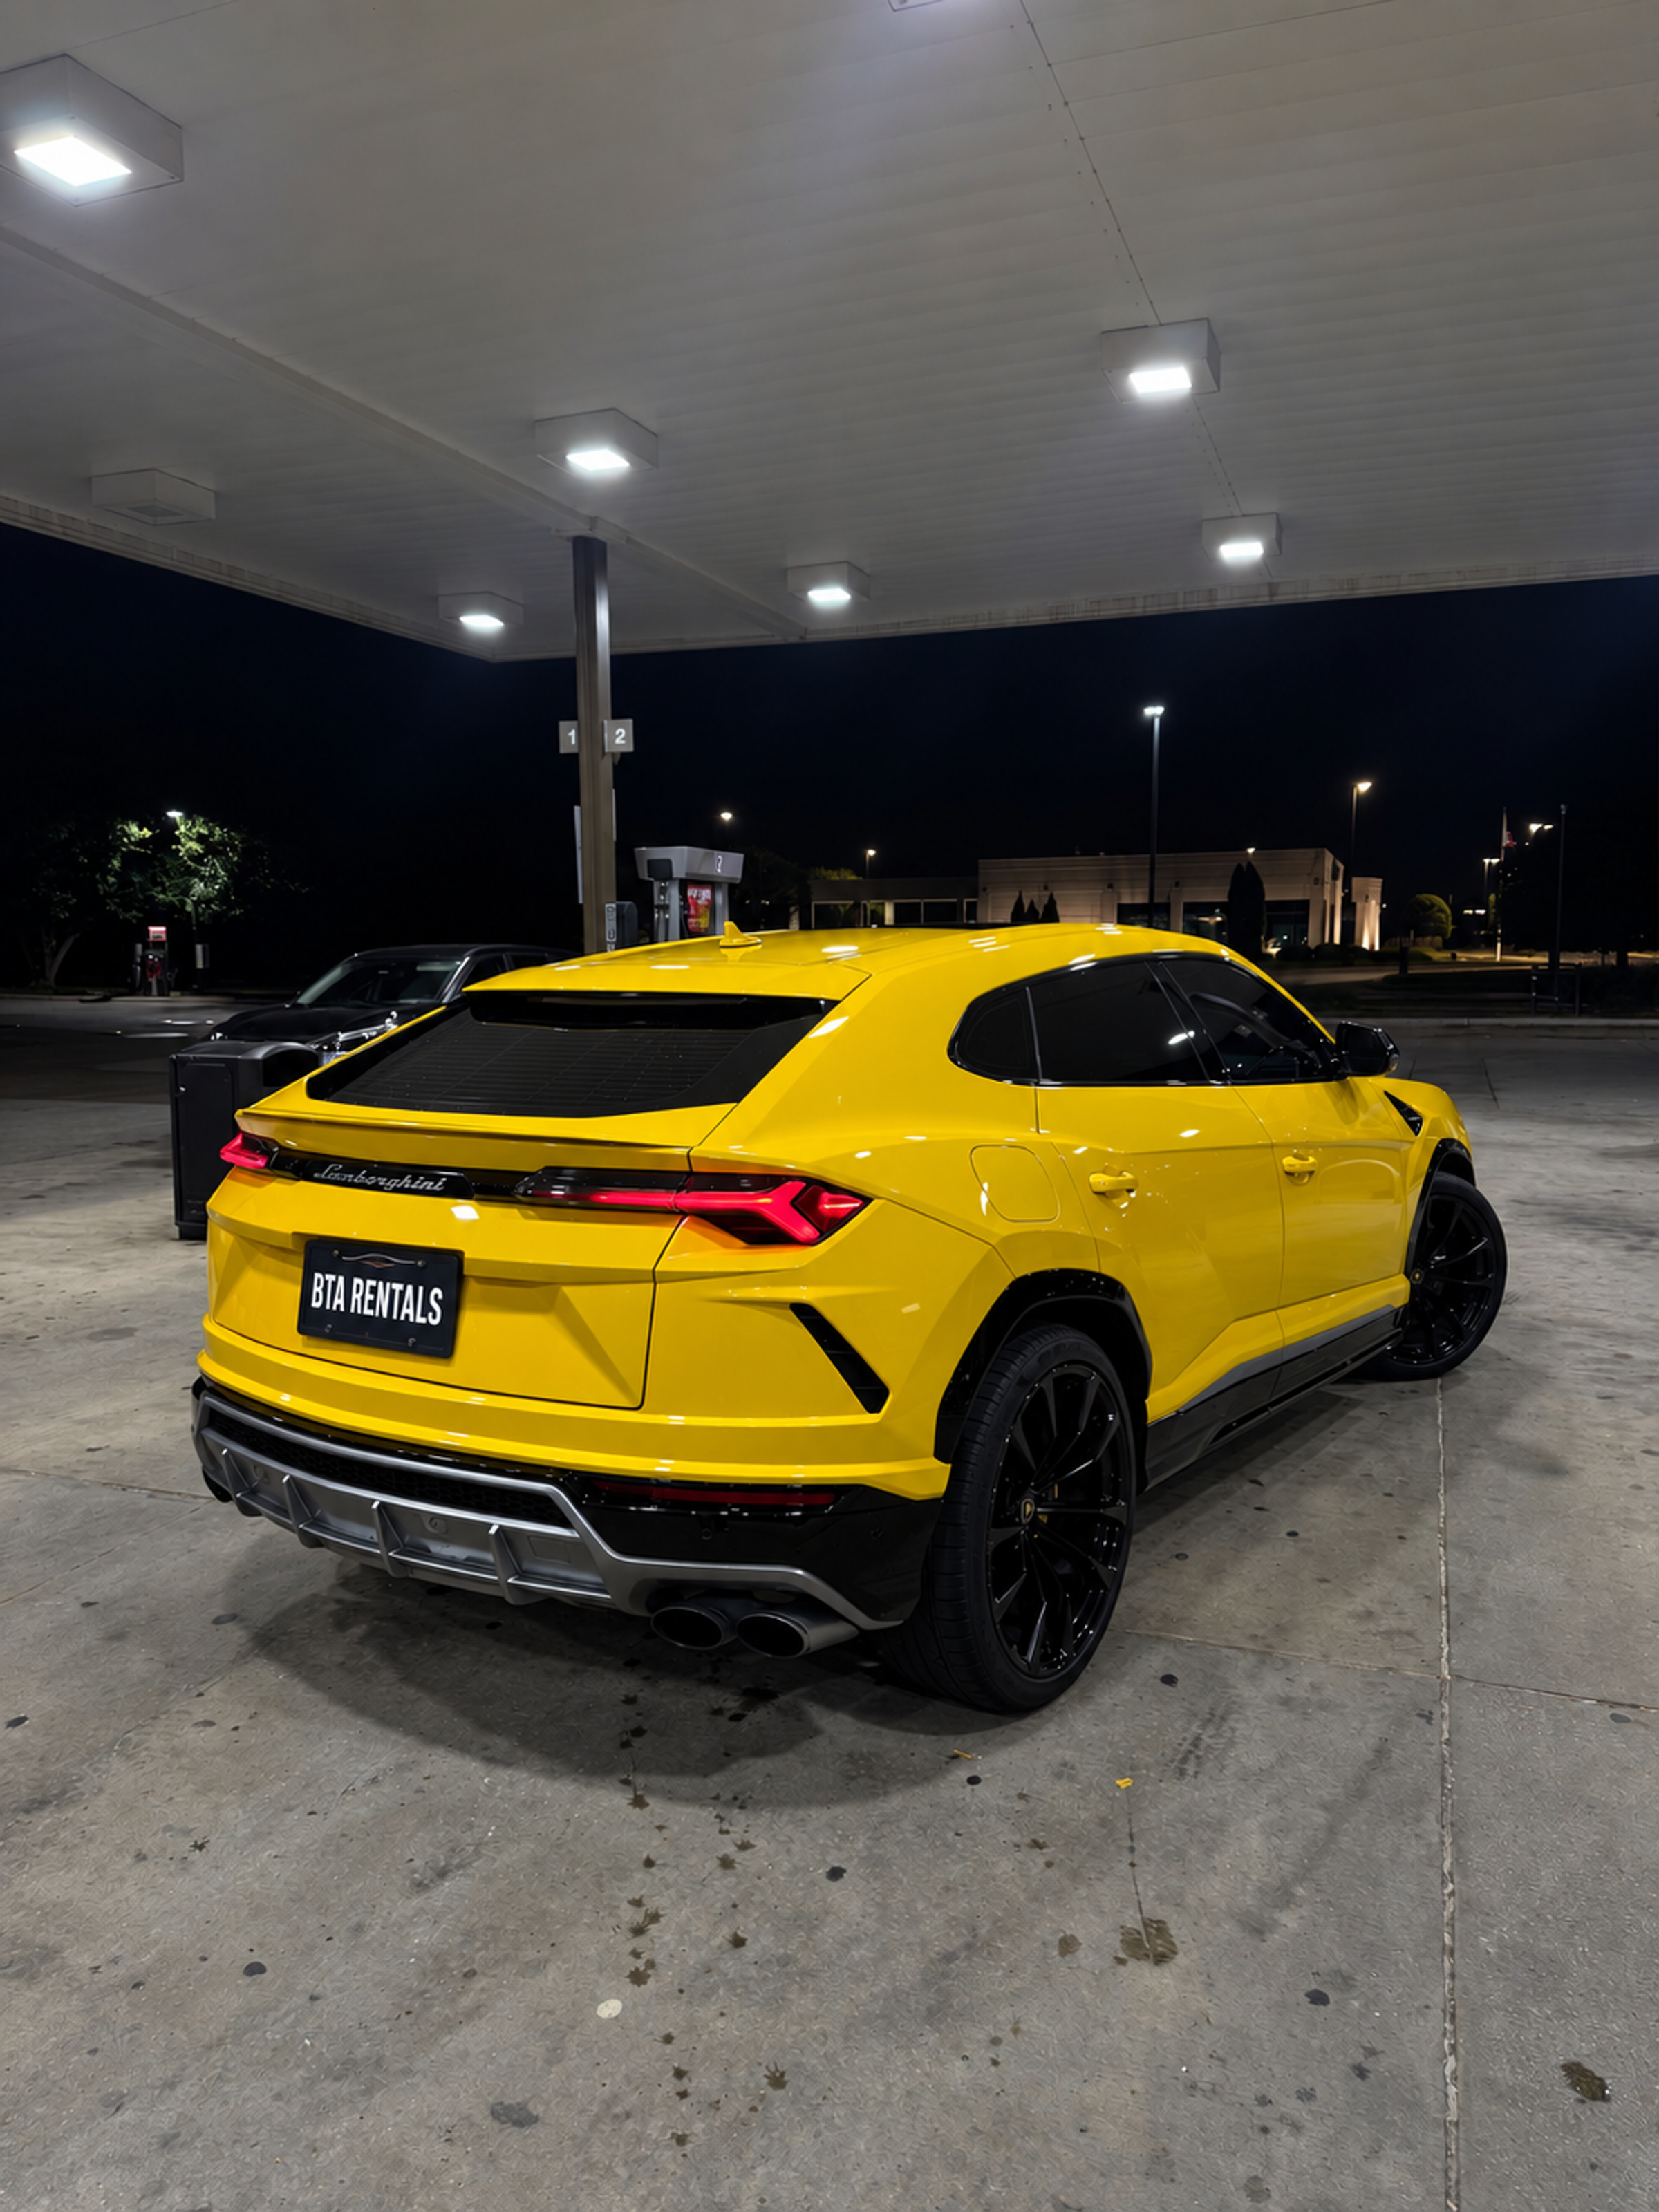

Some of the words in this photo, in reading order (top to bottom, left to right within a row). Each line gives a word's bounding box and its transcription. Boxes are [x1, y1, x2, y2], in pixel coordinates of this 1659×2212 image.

[568, 729, 575, 745] 1
[615, 728, 626, 744] 2
[314, 1163, 447, 1190] Lamborghini
[311, 1272, 345, 1311] BTA
[350, 1277, 443, 1326] RENTALS
